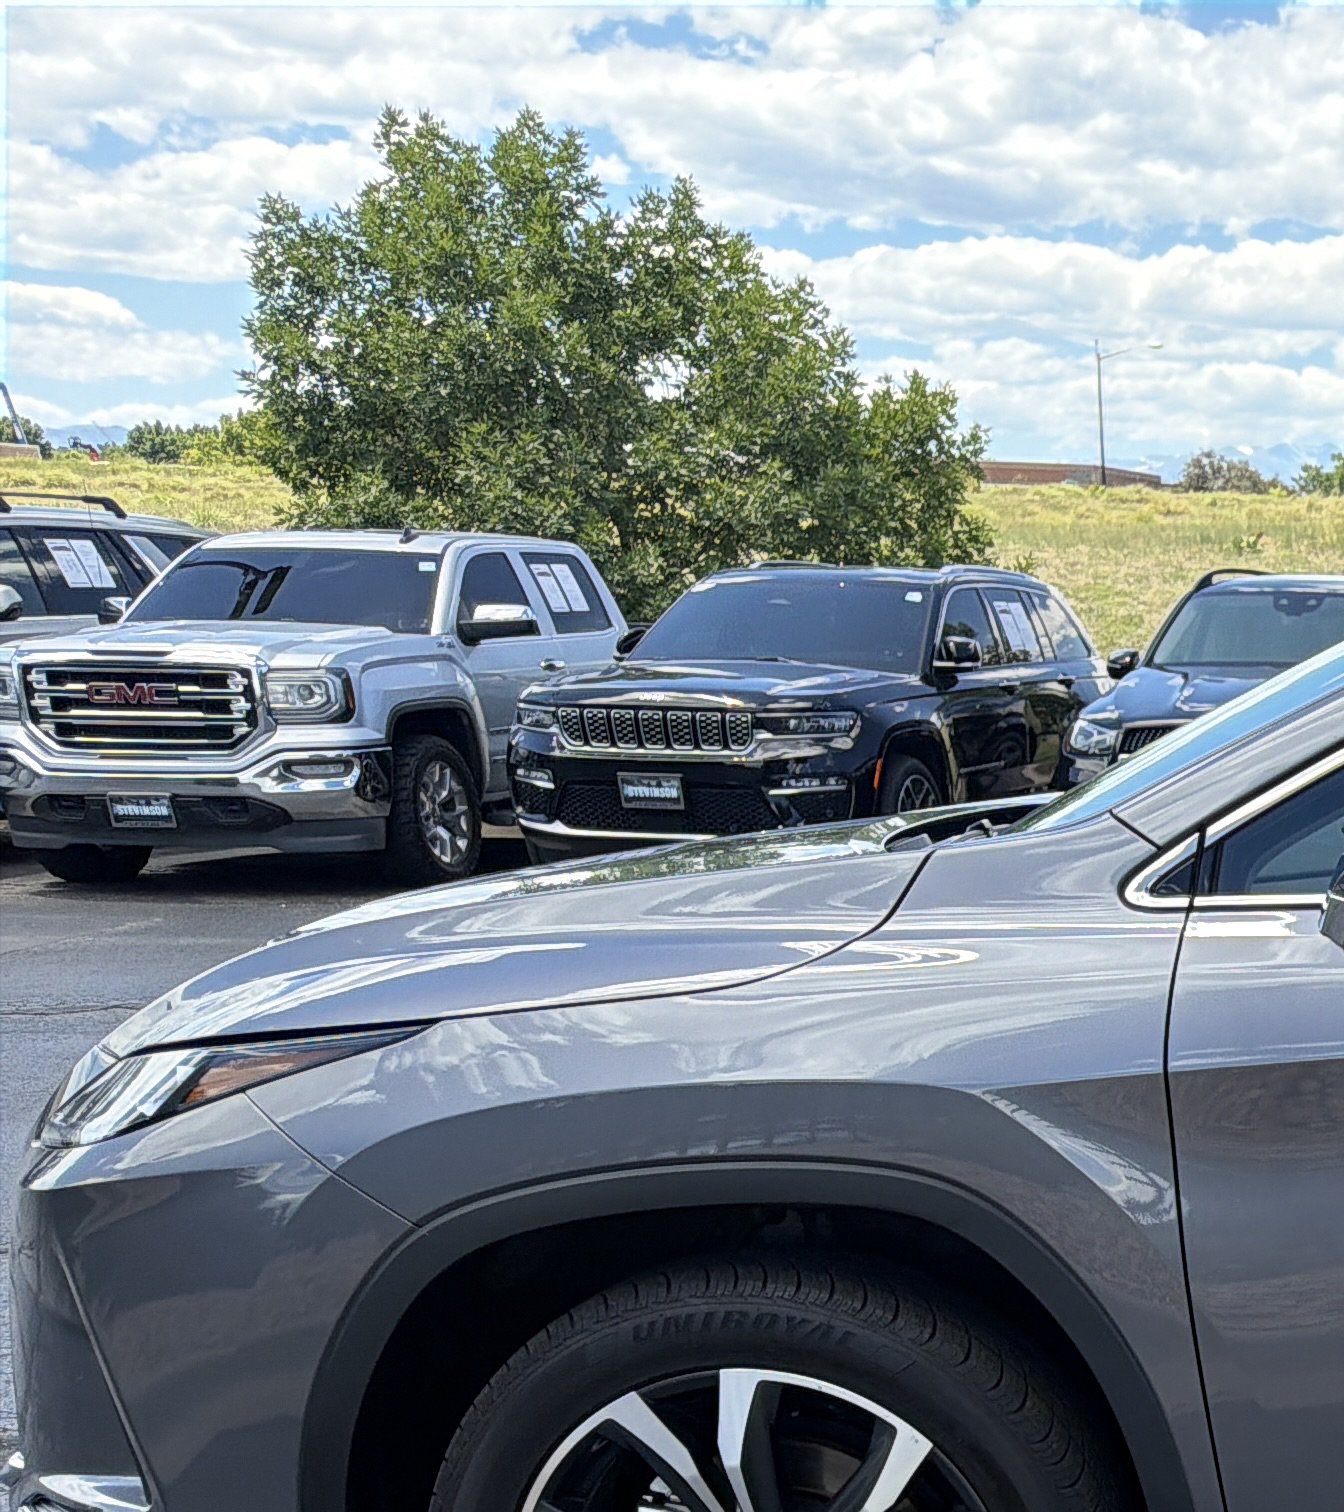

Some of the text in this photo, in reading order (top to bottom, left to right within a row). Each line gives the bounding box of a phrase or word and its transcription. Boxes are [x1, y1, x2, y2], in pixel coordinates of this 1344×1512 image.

[87, 682, 178, 705] GMC
[628, 785, 678, 798] STEVINSON
[116, 805, 169, 816] STEVINSON
[632, 1310, 857, 1345] UNIROYAL
